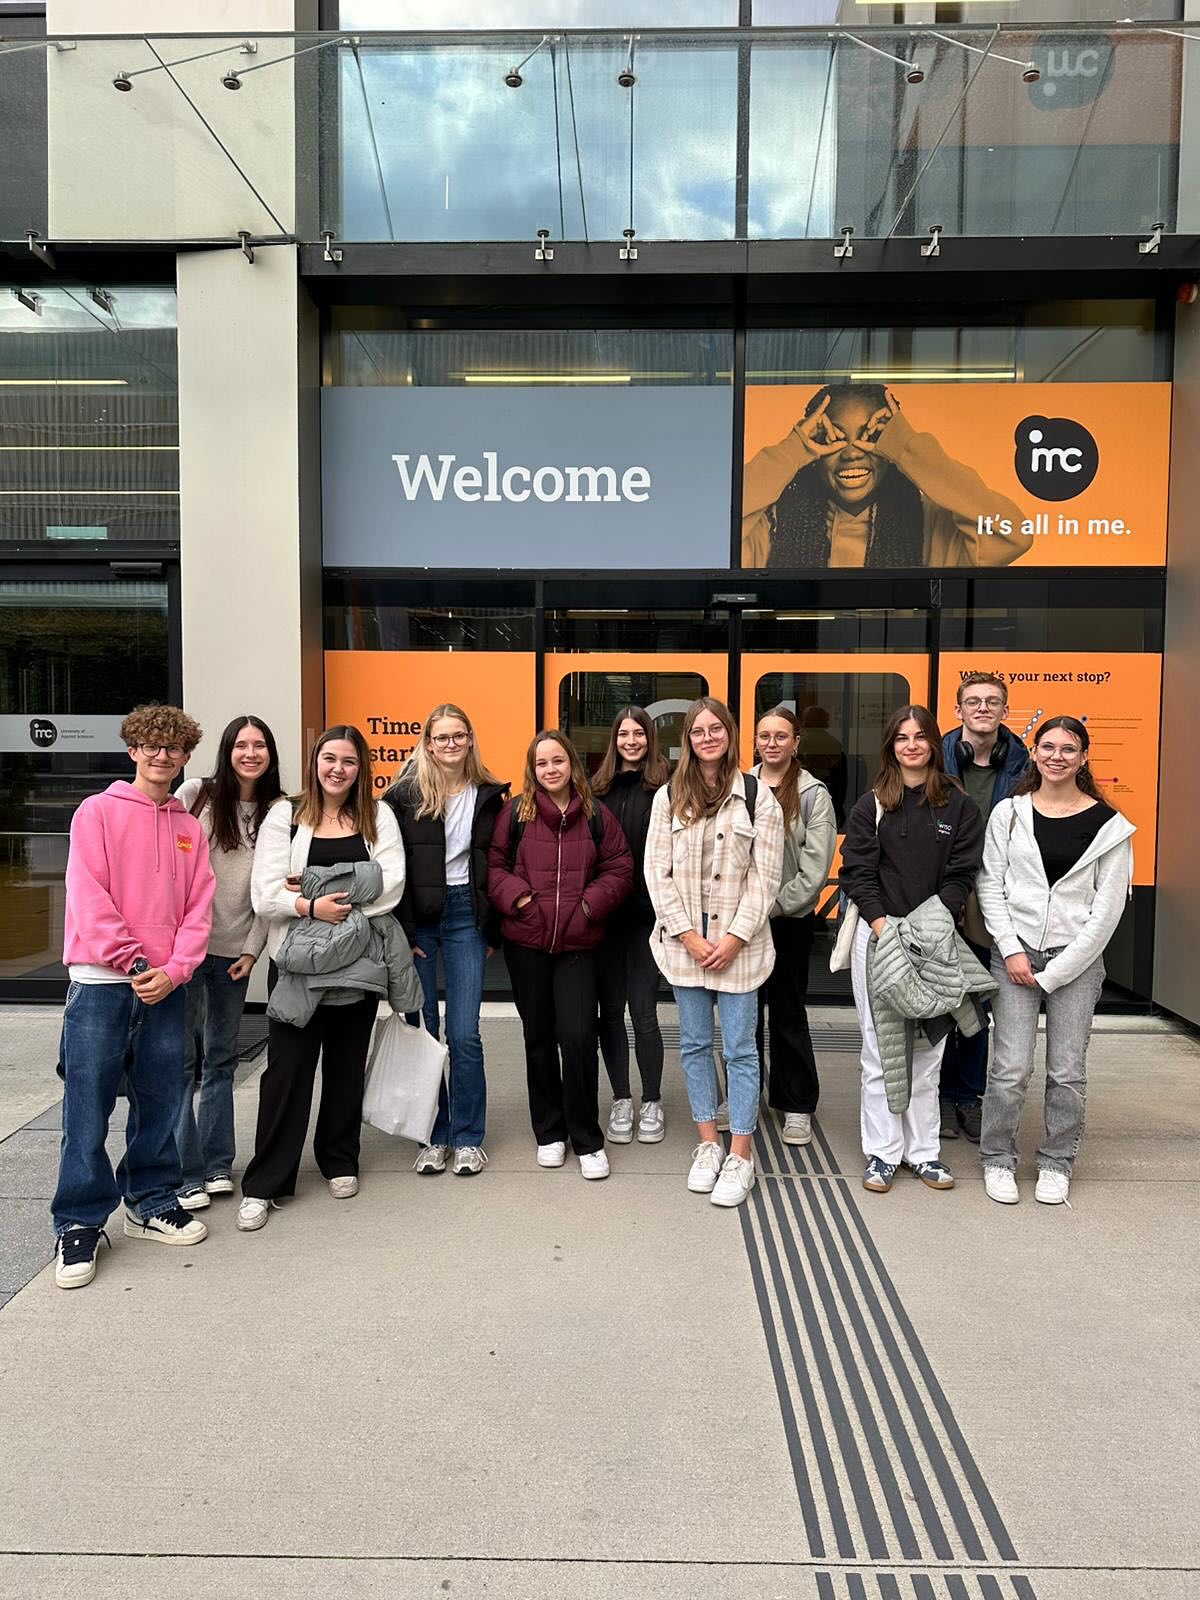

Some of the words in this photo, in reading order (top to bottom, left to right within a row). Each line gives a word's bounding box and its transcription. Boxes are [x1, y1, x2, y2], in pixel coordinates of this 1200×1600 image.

[1028, 429, 1083, 473] imc
[391, 451, 651, 502] Welcome
[977, 513, 1013, 535] It's
[1021, 513, 1049, 535] all
[1057, 514, 1079, 535] in
[1088, 518, 1132, 535] me.
[958, 669, 1005, 681] Wt's
[1008, 672, 1040, 684] your
[1043, 672, 1073, 682] next
[1077, 671, 1111, 684] stop?
[34, 723, 53, 739] imc
[367, 716, 421, 735] Time
